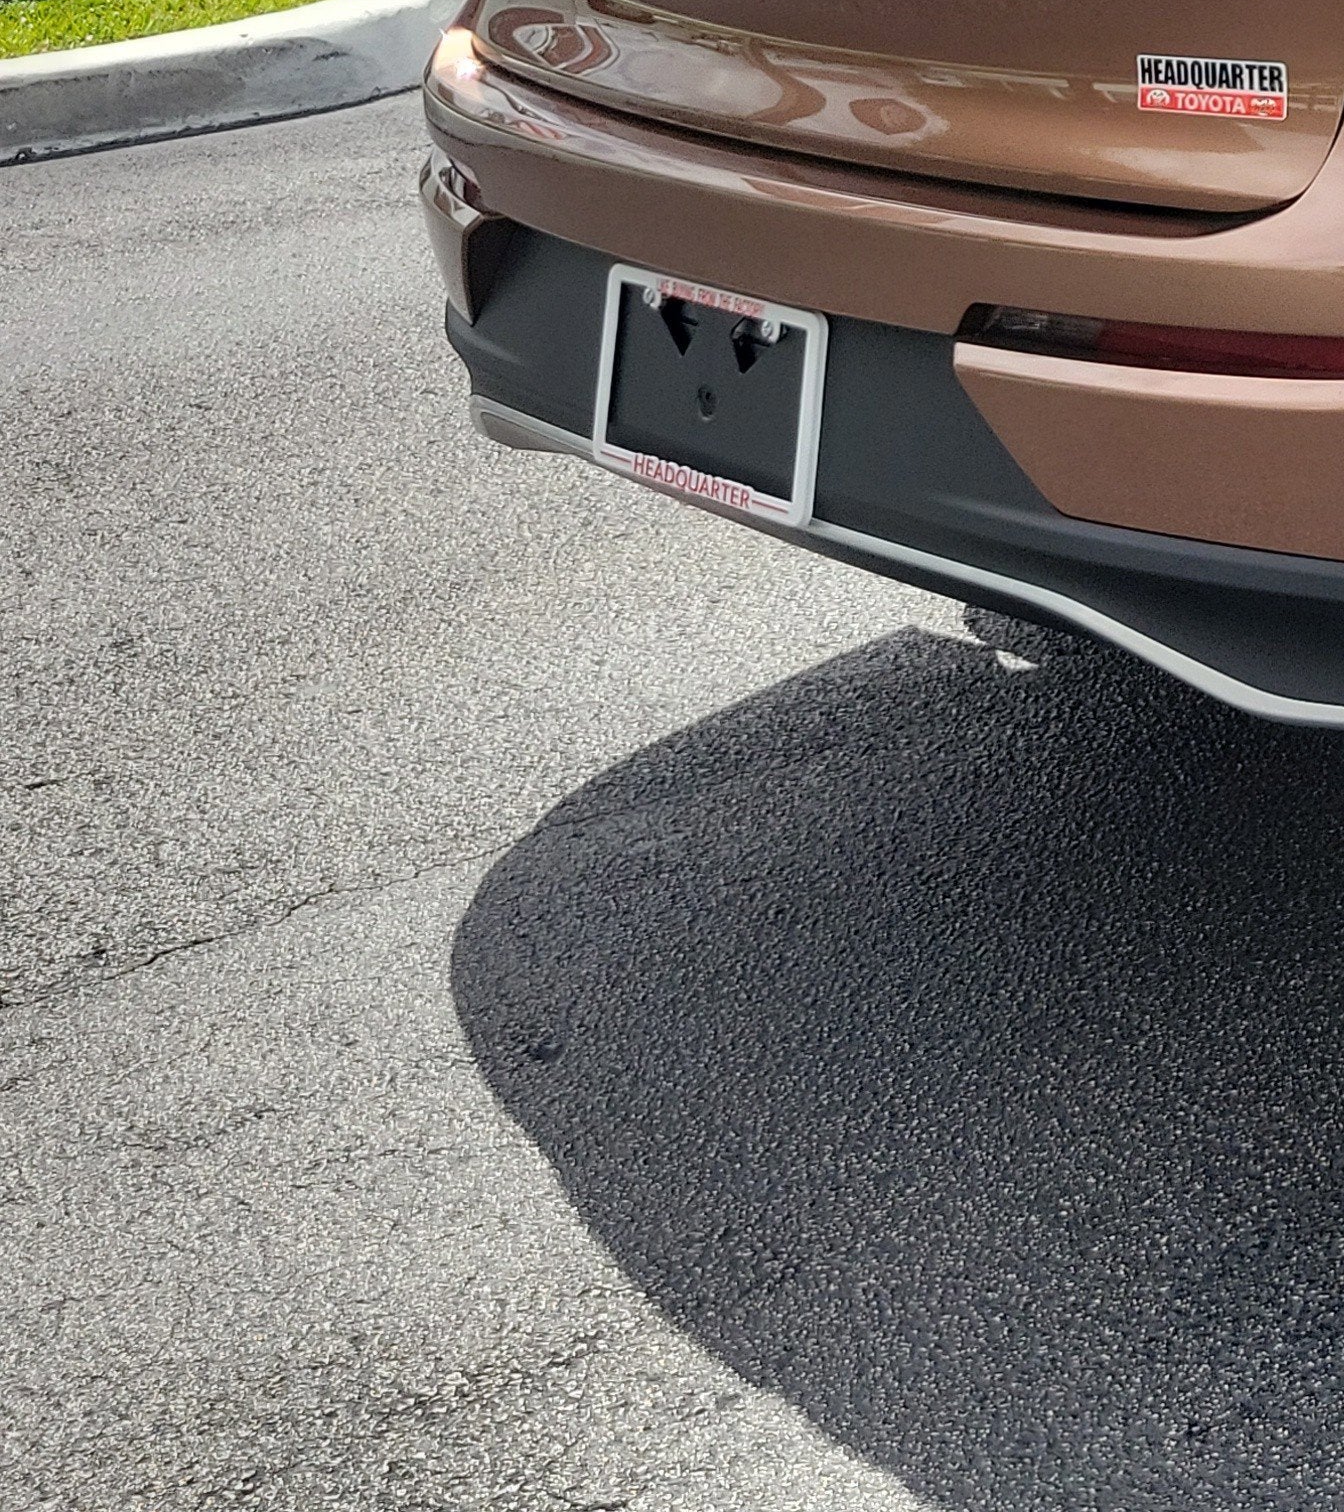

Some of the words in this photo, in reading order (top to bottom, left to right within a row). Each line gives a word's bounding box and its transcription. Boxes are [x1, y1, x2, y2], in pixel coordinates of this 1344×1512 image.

[1140, 57, 1283, 93] HEADQUARTER
[1175, 93, 1246, 114] TOYOTA
[633, 454, 750, 509] HEADQUARTER
